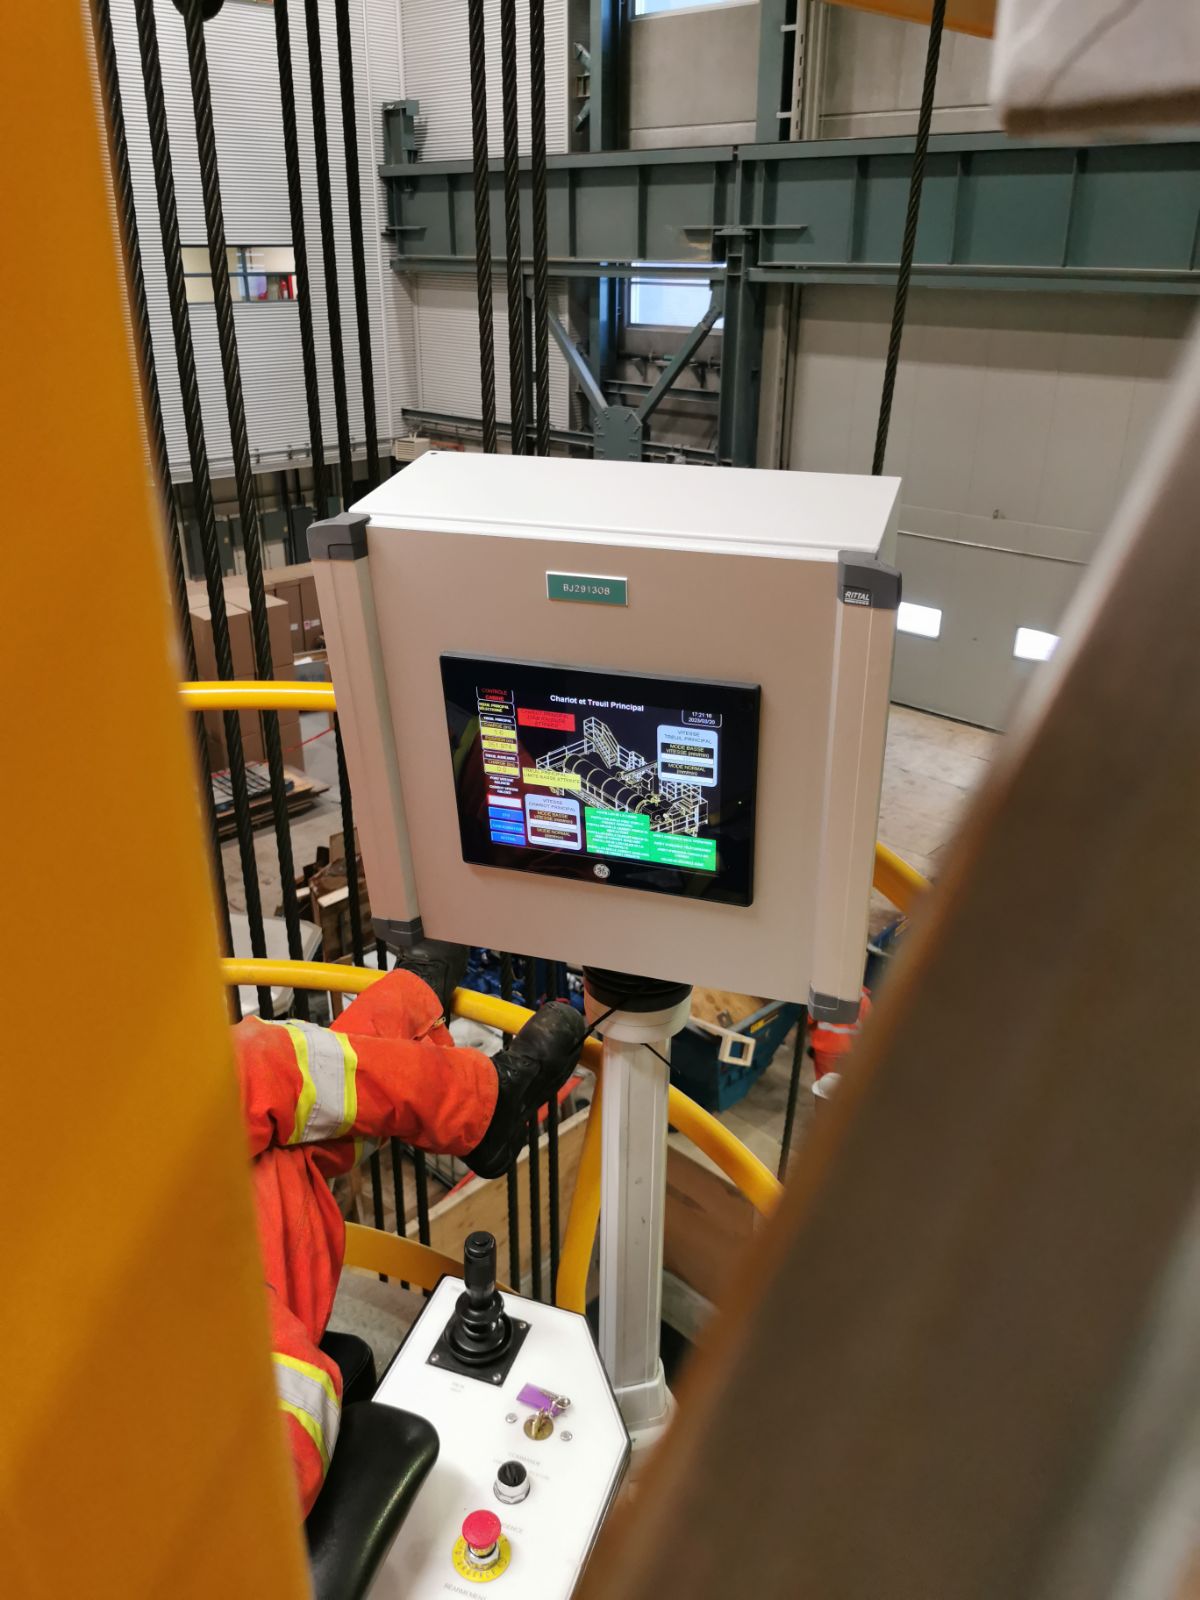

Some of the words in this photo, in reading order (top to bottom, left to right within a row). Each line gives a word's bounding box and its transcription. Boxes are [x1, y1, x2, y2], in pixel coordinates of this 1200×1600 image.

[563, 583, 610, 595] BJ291308
[845, 591, 870, 600] RITTAL
[550, 694, 577, 704] Chariot
[587, 699, 609, 708] Treuil
[610, 702, 644, 712] Principal
